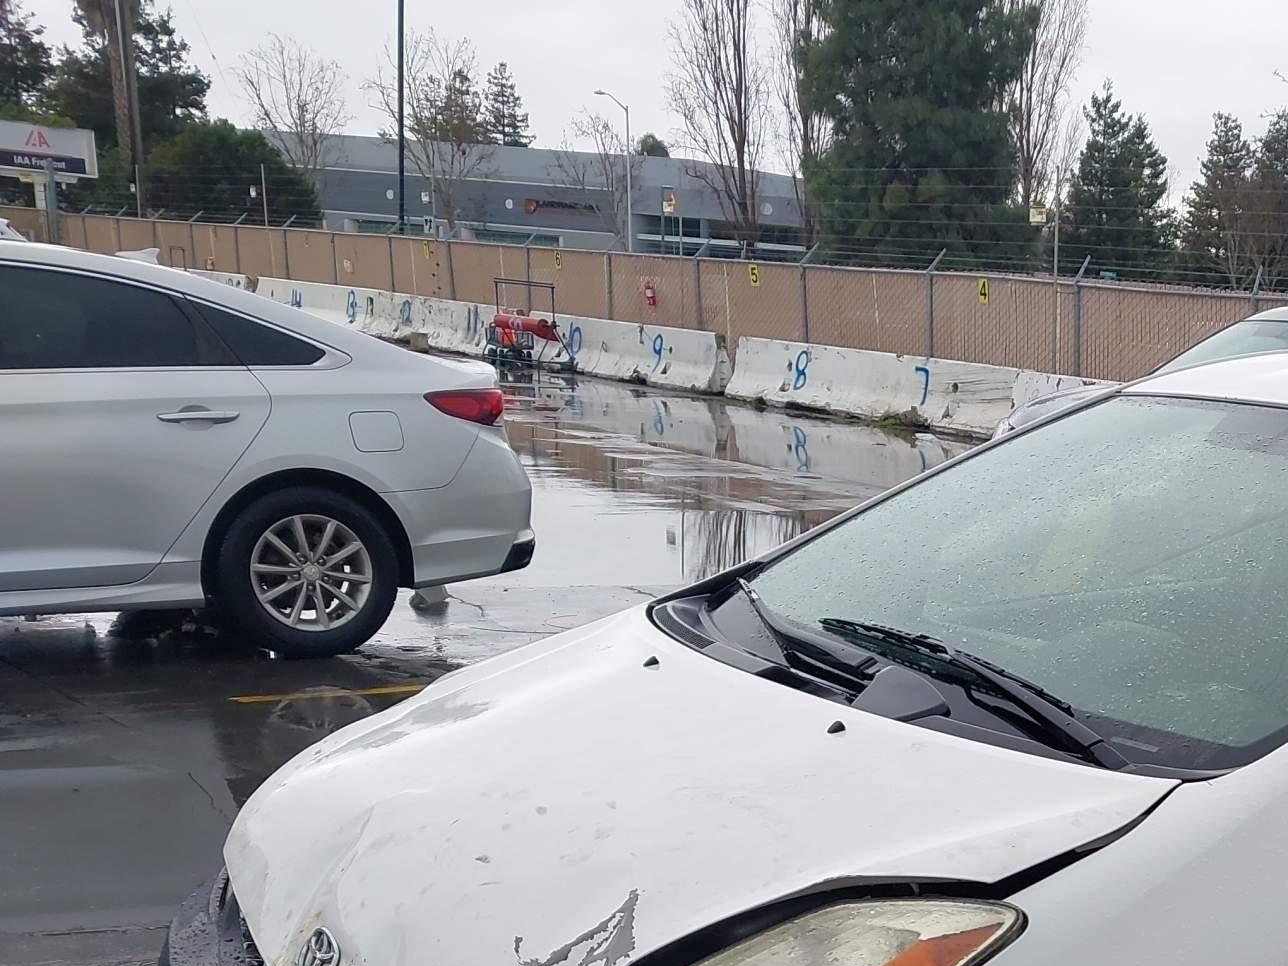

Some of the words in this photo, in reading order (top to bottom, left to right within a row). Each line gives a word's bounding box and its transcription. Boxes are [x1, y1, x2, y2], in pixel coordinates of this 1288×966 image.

[14, 155, 31, 166] IAA
[751, 267, 758, 283] 5
[980, 282, 987, 301] 4
[652, 333, 664, 374] 9
[793, 350, 809, 391] 8
[914, 365, 929, 406] 7
